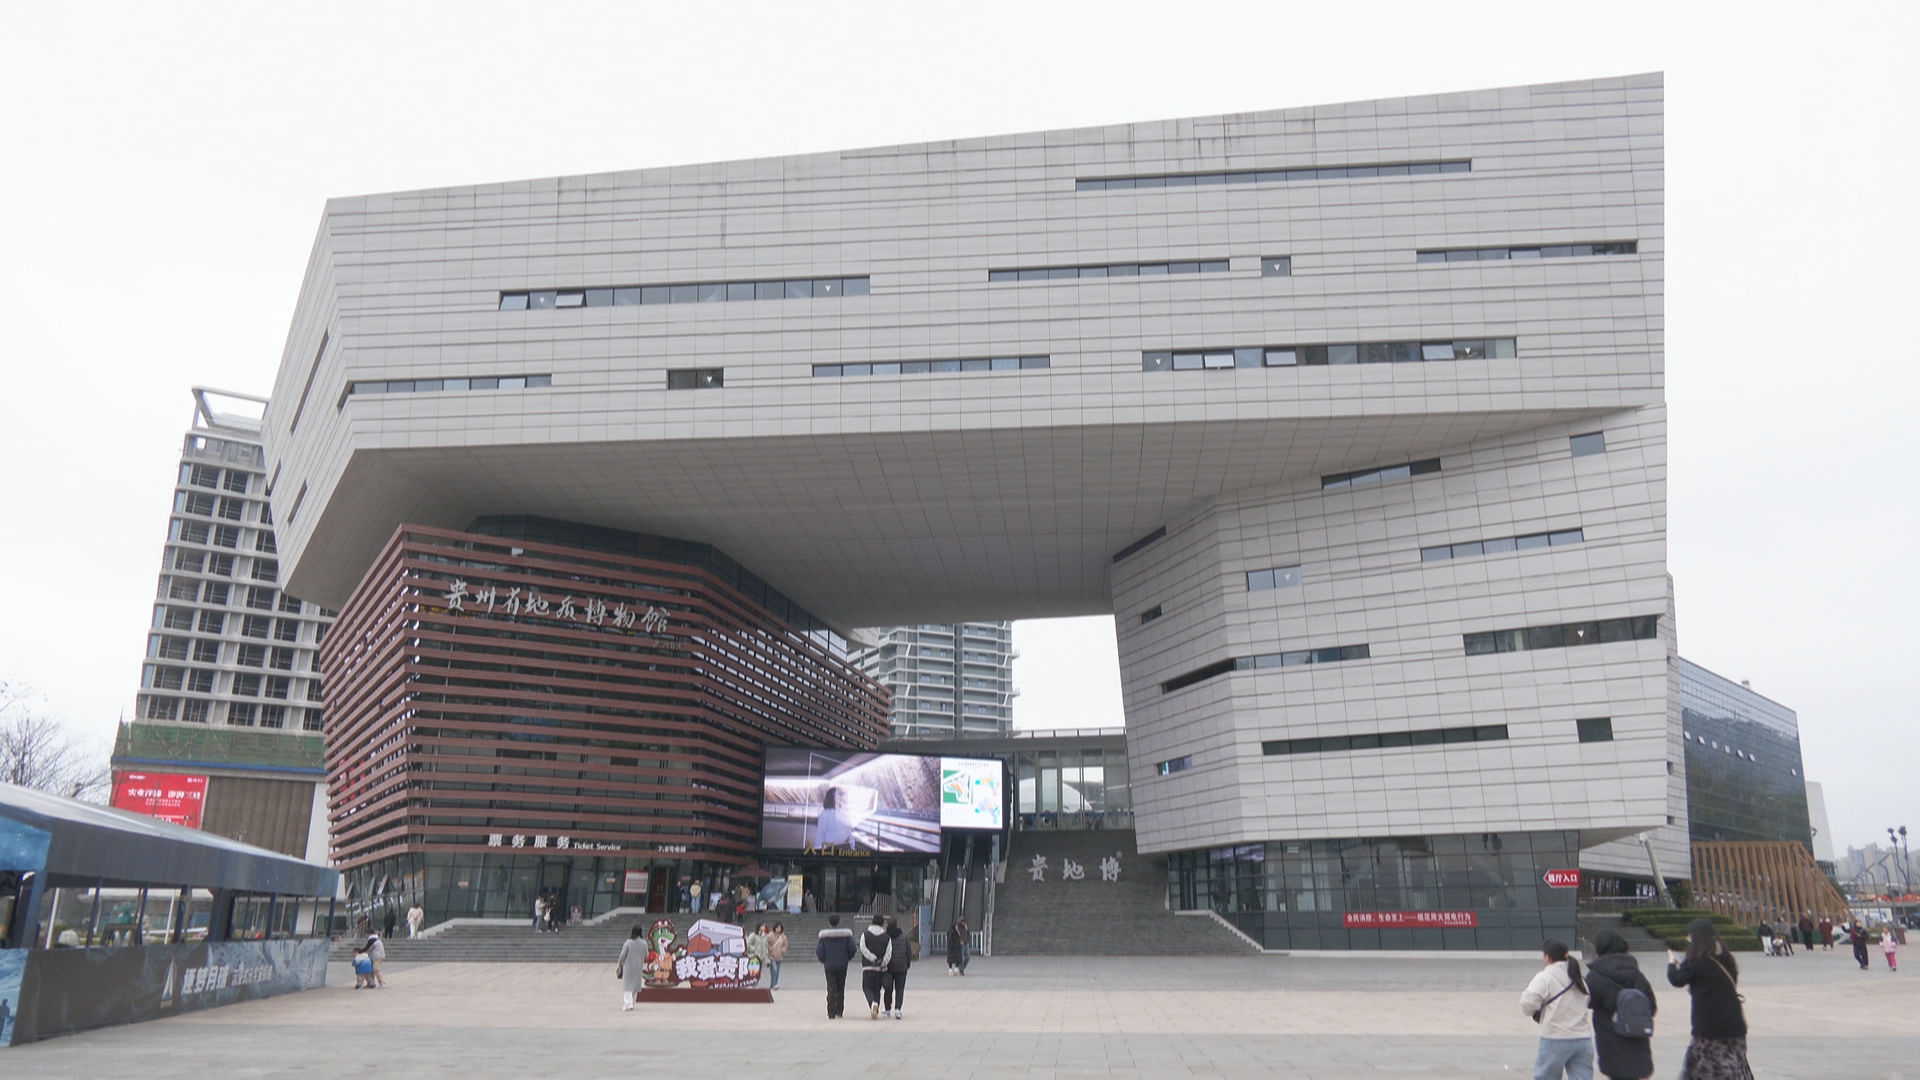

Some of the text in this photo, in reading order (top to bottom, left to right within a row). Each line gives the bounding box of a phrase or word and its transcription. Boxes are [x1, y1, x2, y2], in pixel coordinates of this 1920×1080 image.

[443, 578, 671, 633] 贵州省地质博物馆
[487, 833, 622, 851] 票务服务 Ticket Service
[803, 841, 871, 857] 入口 Entrance
